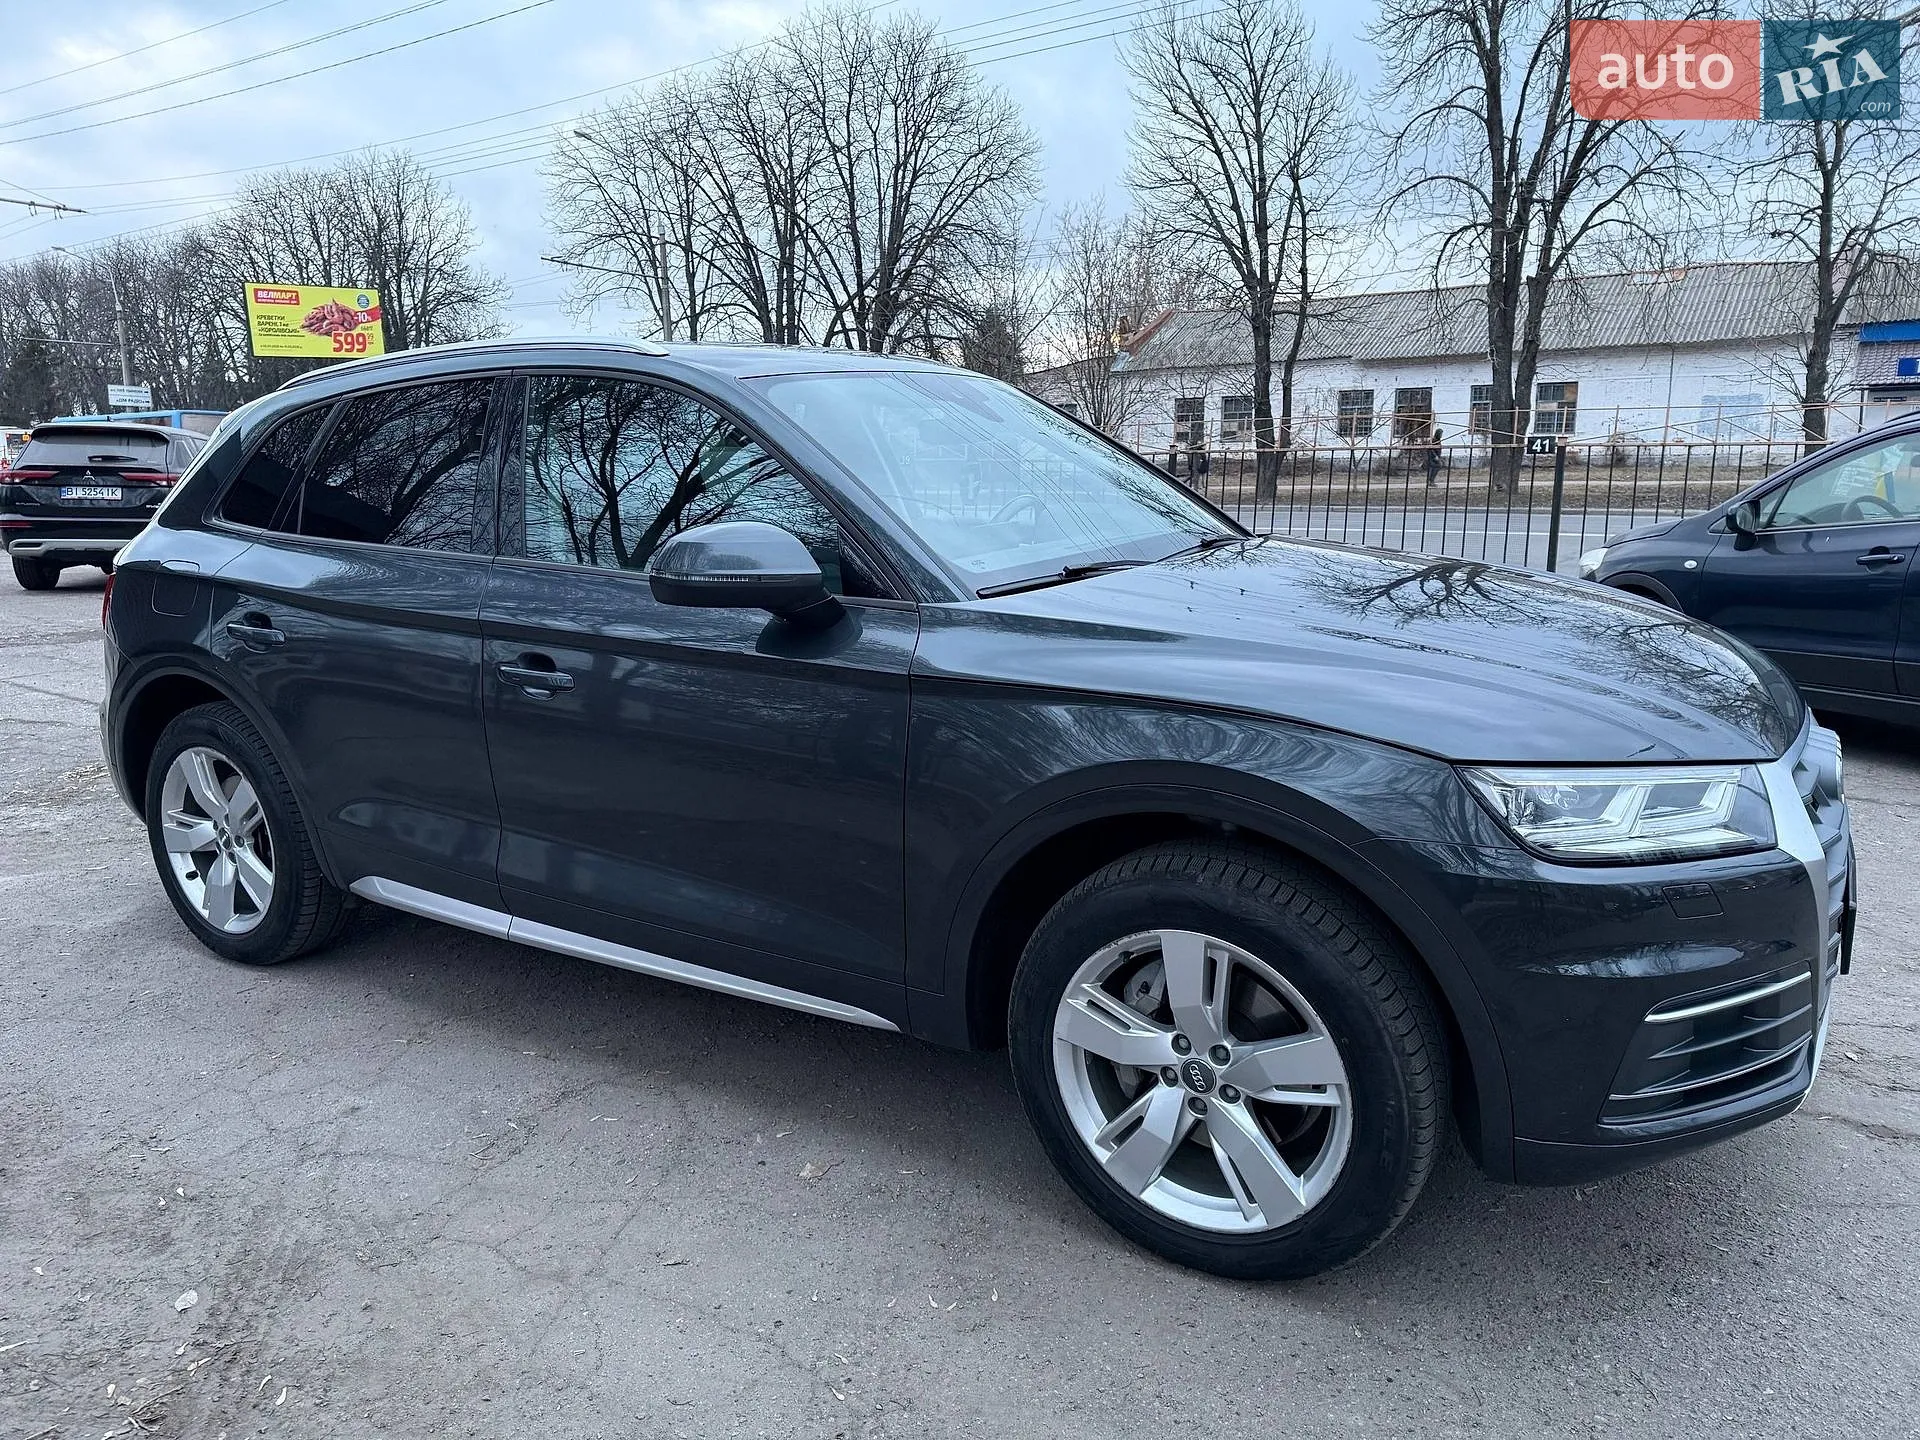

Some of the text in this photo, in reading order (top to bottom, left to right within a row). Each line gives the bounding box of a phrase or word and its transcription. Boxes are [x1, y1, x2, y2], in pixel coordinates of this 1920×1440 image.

[257, 290, 297, 299] ВЕЛМАРТ
[333, 333, 367, 352] 599
[1532, 438, 1550, 453] 41
[66, 487, 118, 497] BI 5254 IK
